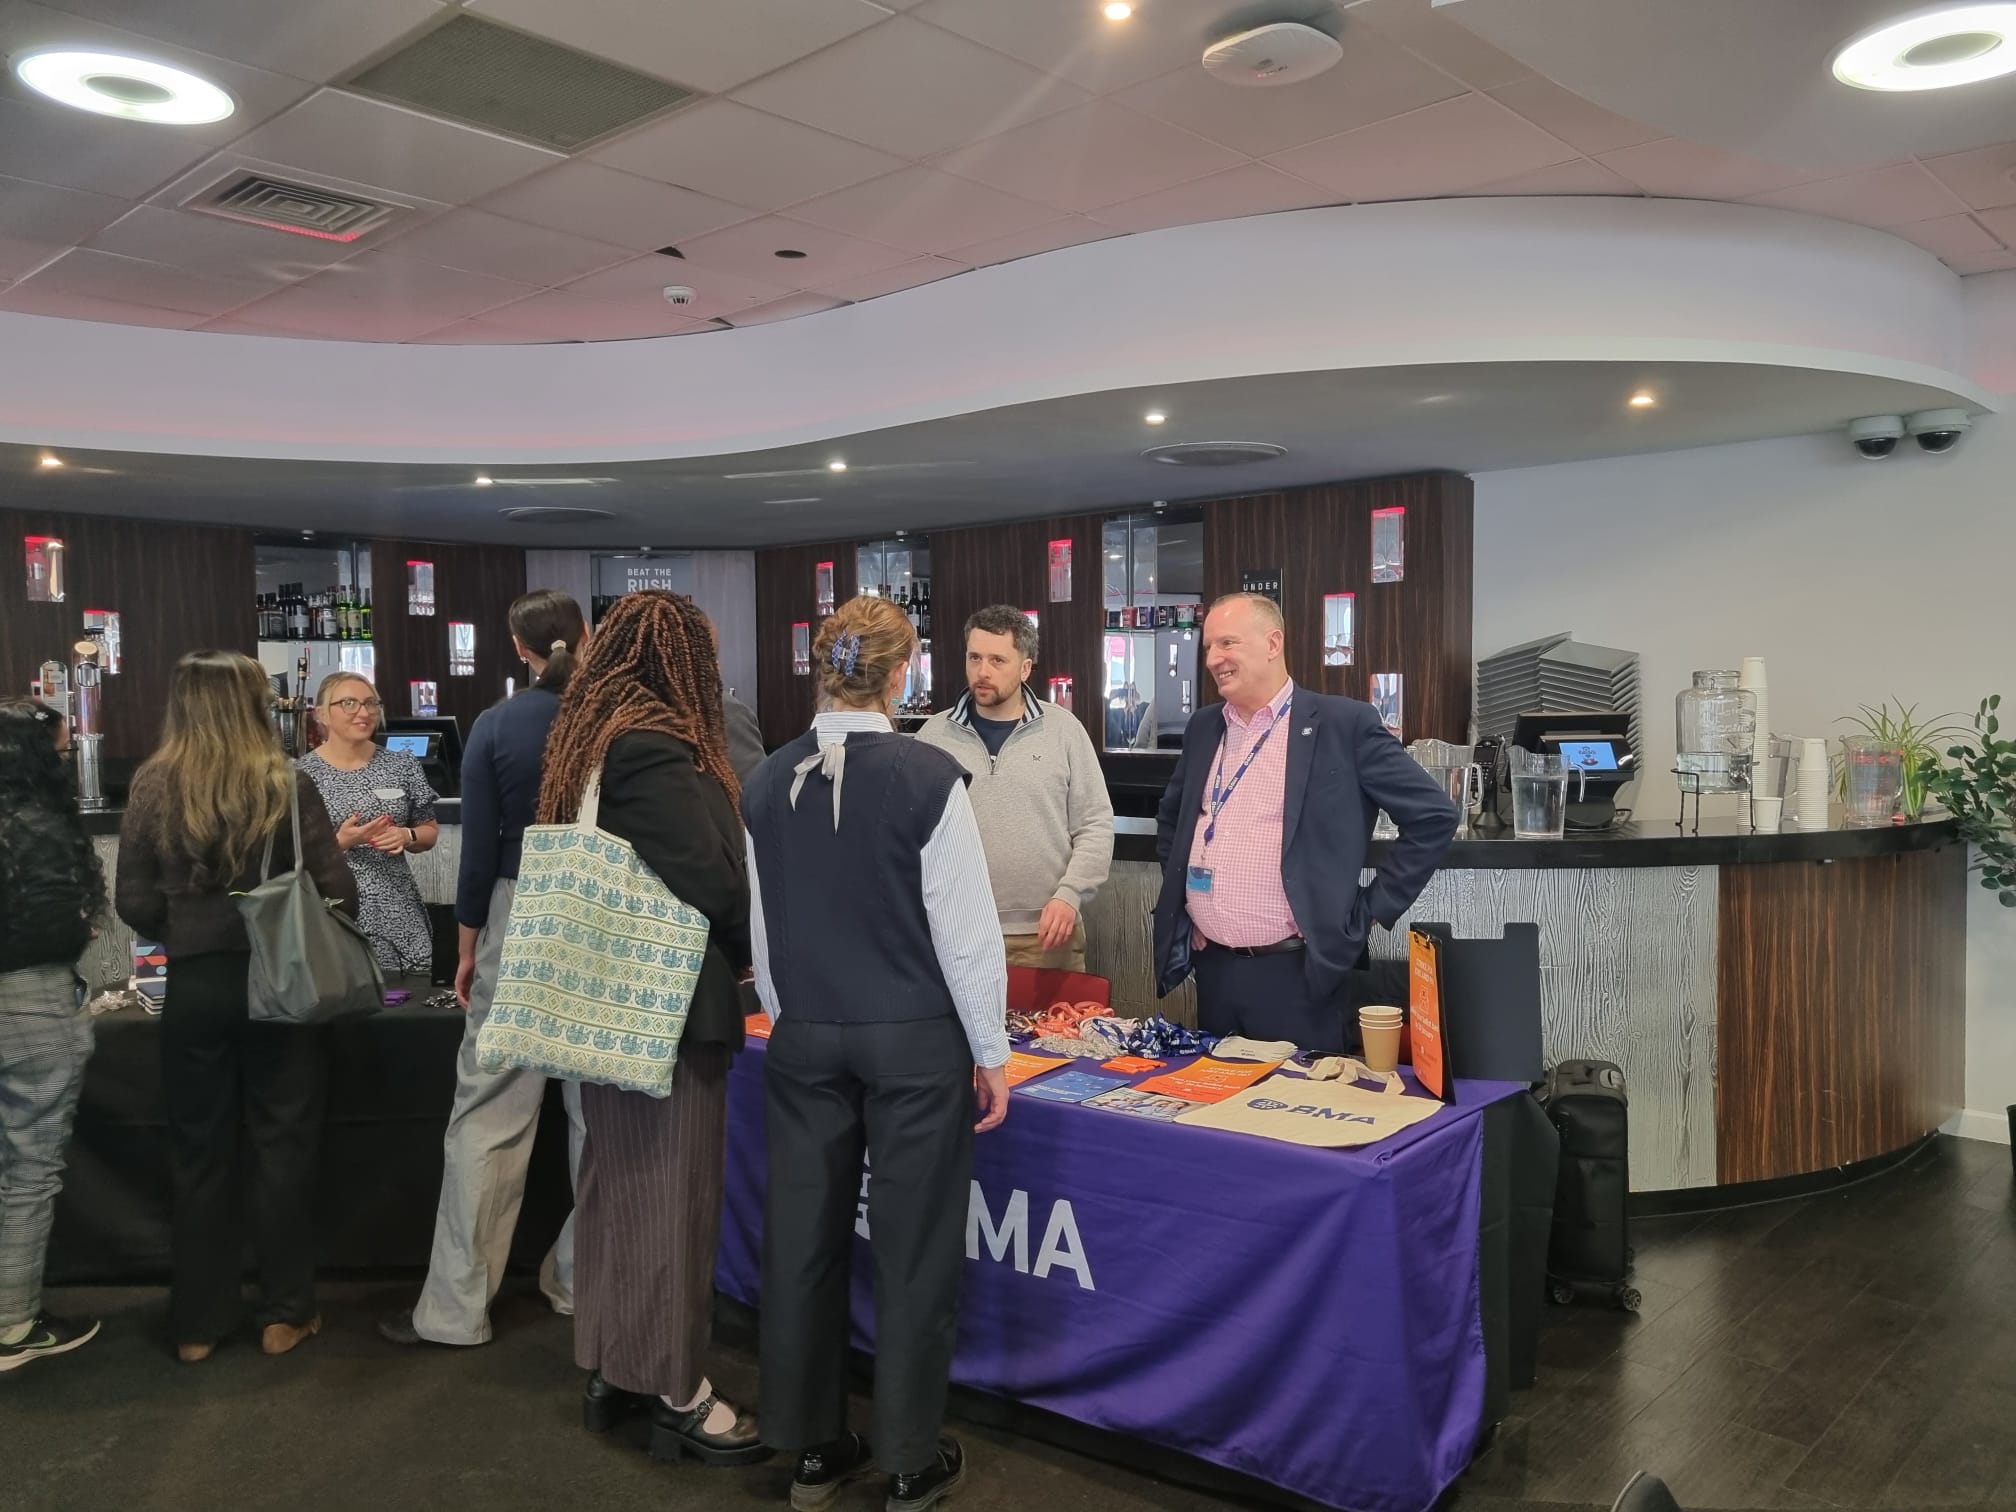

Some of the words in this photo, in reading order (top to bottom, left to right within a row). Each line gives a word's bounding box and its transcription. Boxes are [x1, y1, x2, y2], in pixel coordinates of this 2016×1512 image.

[627, 568, 650, 576] BEAT
[654, 568, 672, 576] THE
[627, 578, 672, 593] RUSH
[1243, 581, 1278, 592] UNDER
[1287, 1105, 1376, 1125] BMA
[965, 1178, 1096, 1291] MA
